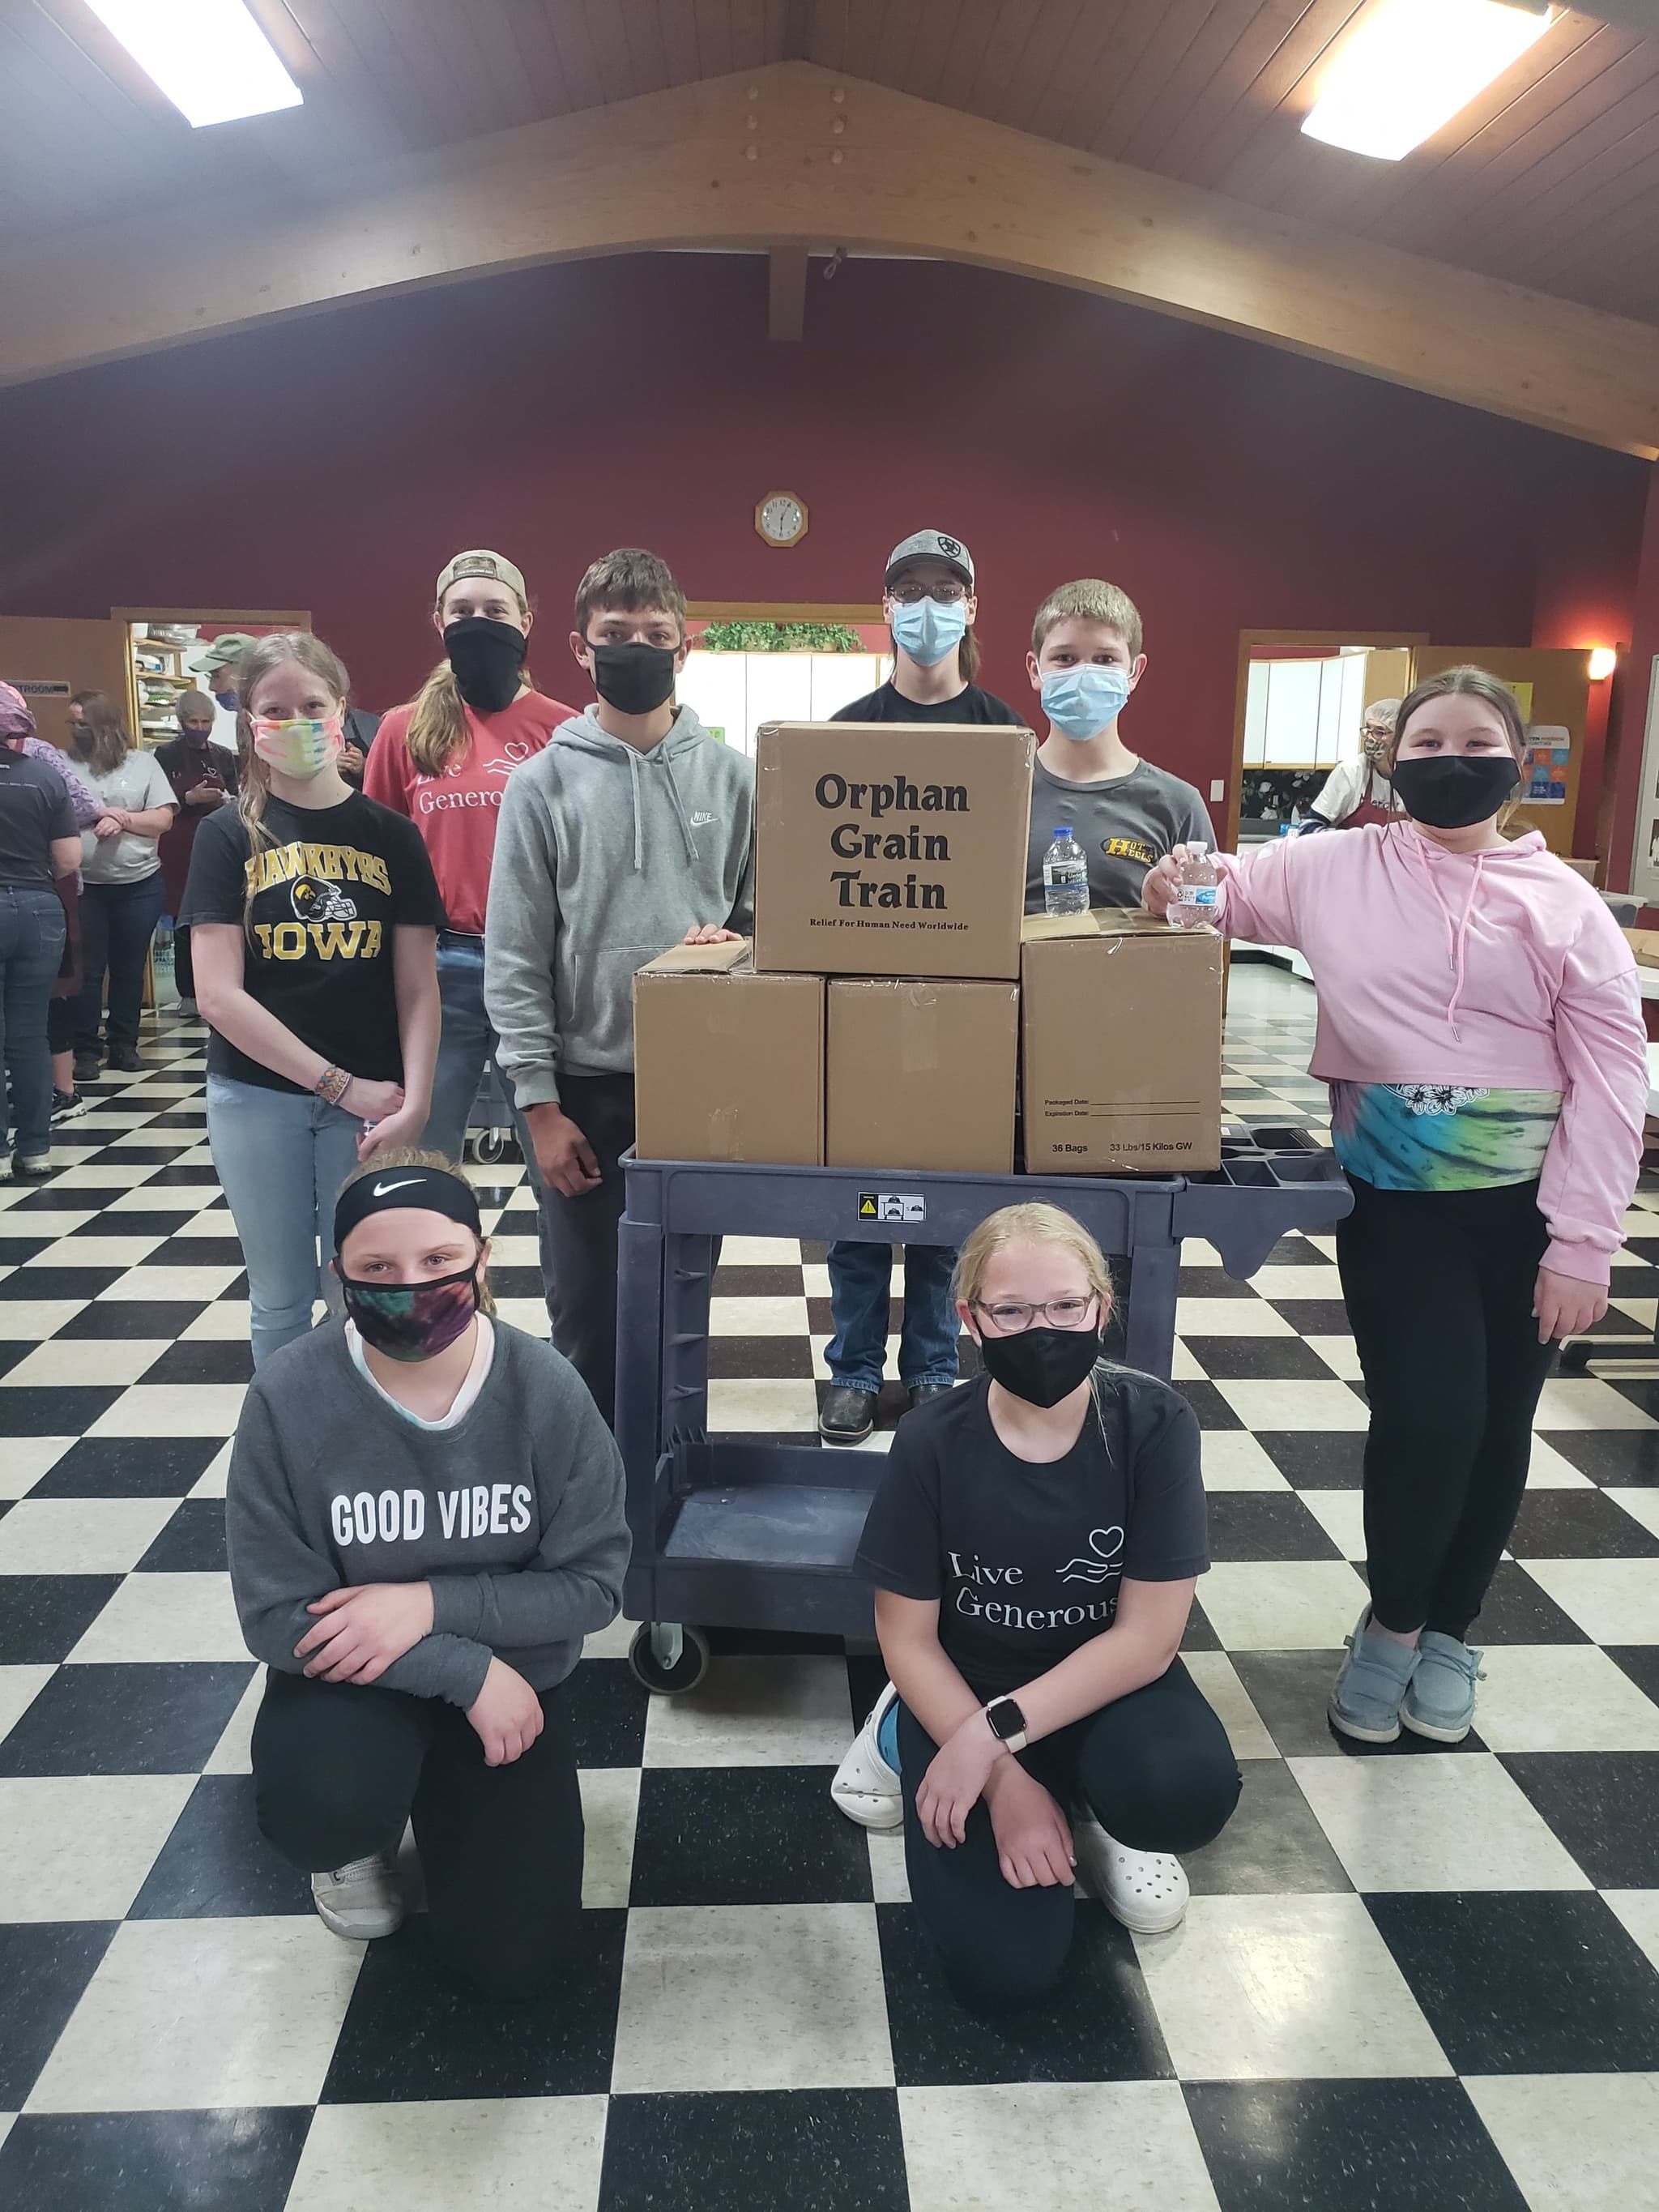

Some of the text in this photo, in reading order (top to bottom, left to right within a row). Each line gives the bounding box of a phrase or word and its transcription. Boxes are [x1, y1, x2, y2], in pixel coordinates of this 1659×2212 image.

[815, 773, 970, 818] Orphan
[693, 811, 712, 822] NIKE
[830, 823, 951, 860] Grain
[830, 870, 948, 909] Train
[254, 920, 382, 960] IOWA
[810, 918, 838, 927] Relief
[857, 920, 890, 929] Human
[892, 921, 916, 929] Need
[919, 922, 969, 931] Worldwide
[1052, 1144, 1088, 1154] 36 Bags
[1110, 1142, 1192, 1151] 33 Lbs/15 Kilos GW
[331, 1484, 531, 1546] GOOD VIBES
[948, 1551, 1024, 1585] Live
